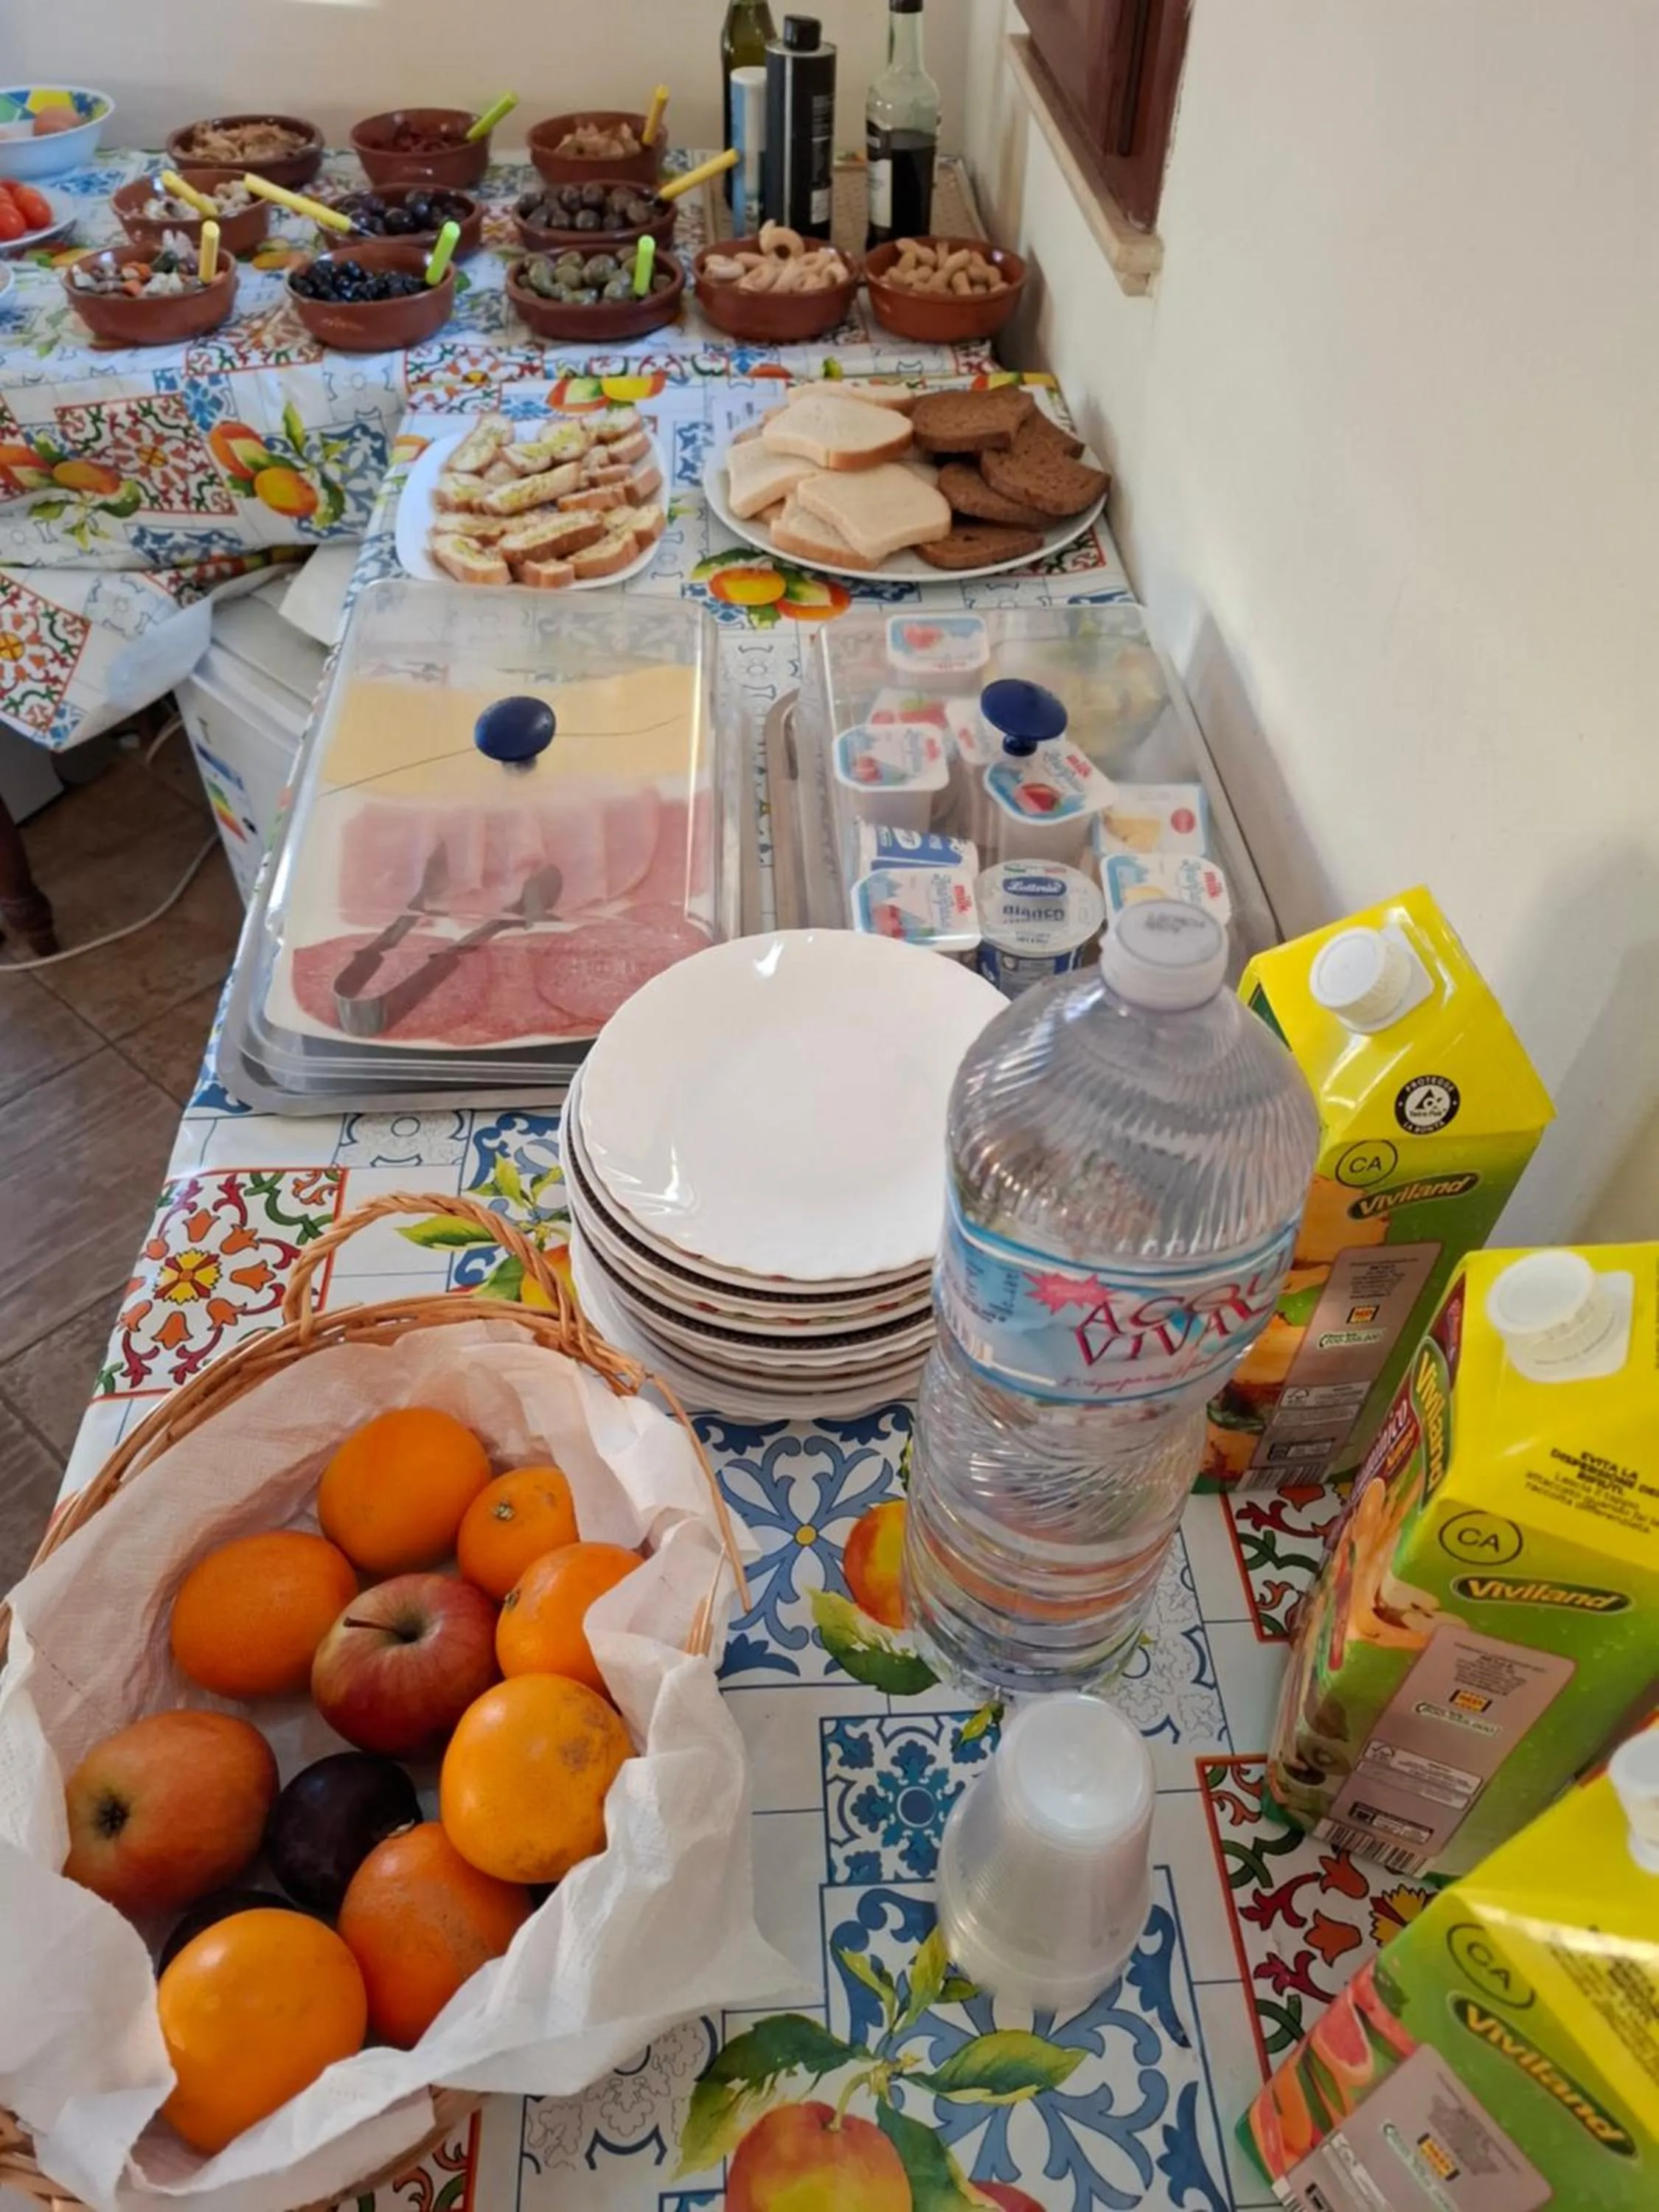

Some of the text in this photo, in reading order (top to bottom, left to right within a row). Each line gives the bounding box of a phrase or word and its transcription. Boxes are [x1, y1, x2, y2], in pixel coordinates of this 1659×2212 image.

[1349, 1155, 1382, 1174] CA
[1360, 1175, 1475, 1215] Viviland
[1416, 1349, 1445, 1492] Viviland
[1457, 1527, 1500, 1553] CA
[1467, 1579, 1621, 1610] Viviland
[1467, 1941, 1510, 1991] CA
[1467, 2003, 1627, 2140] Viviland
